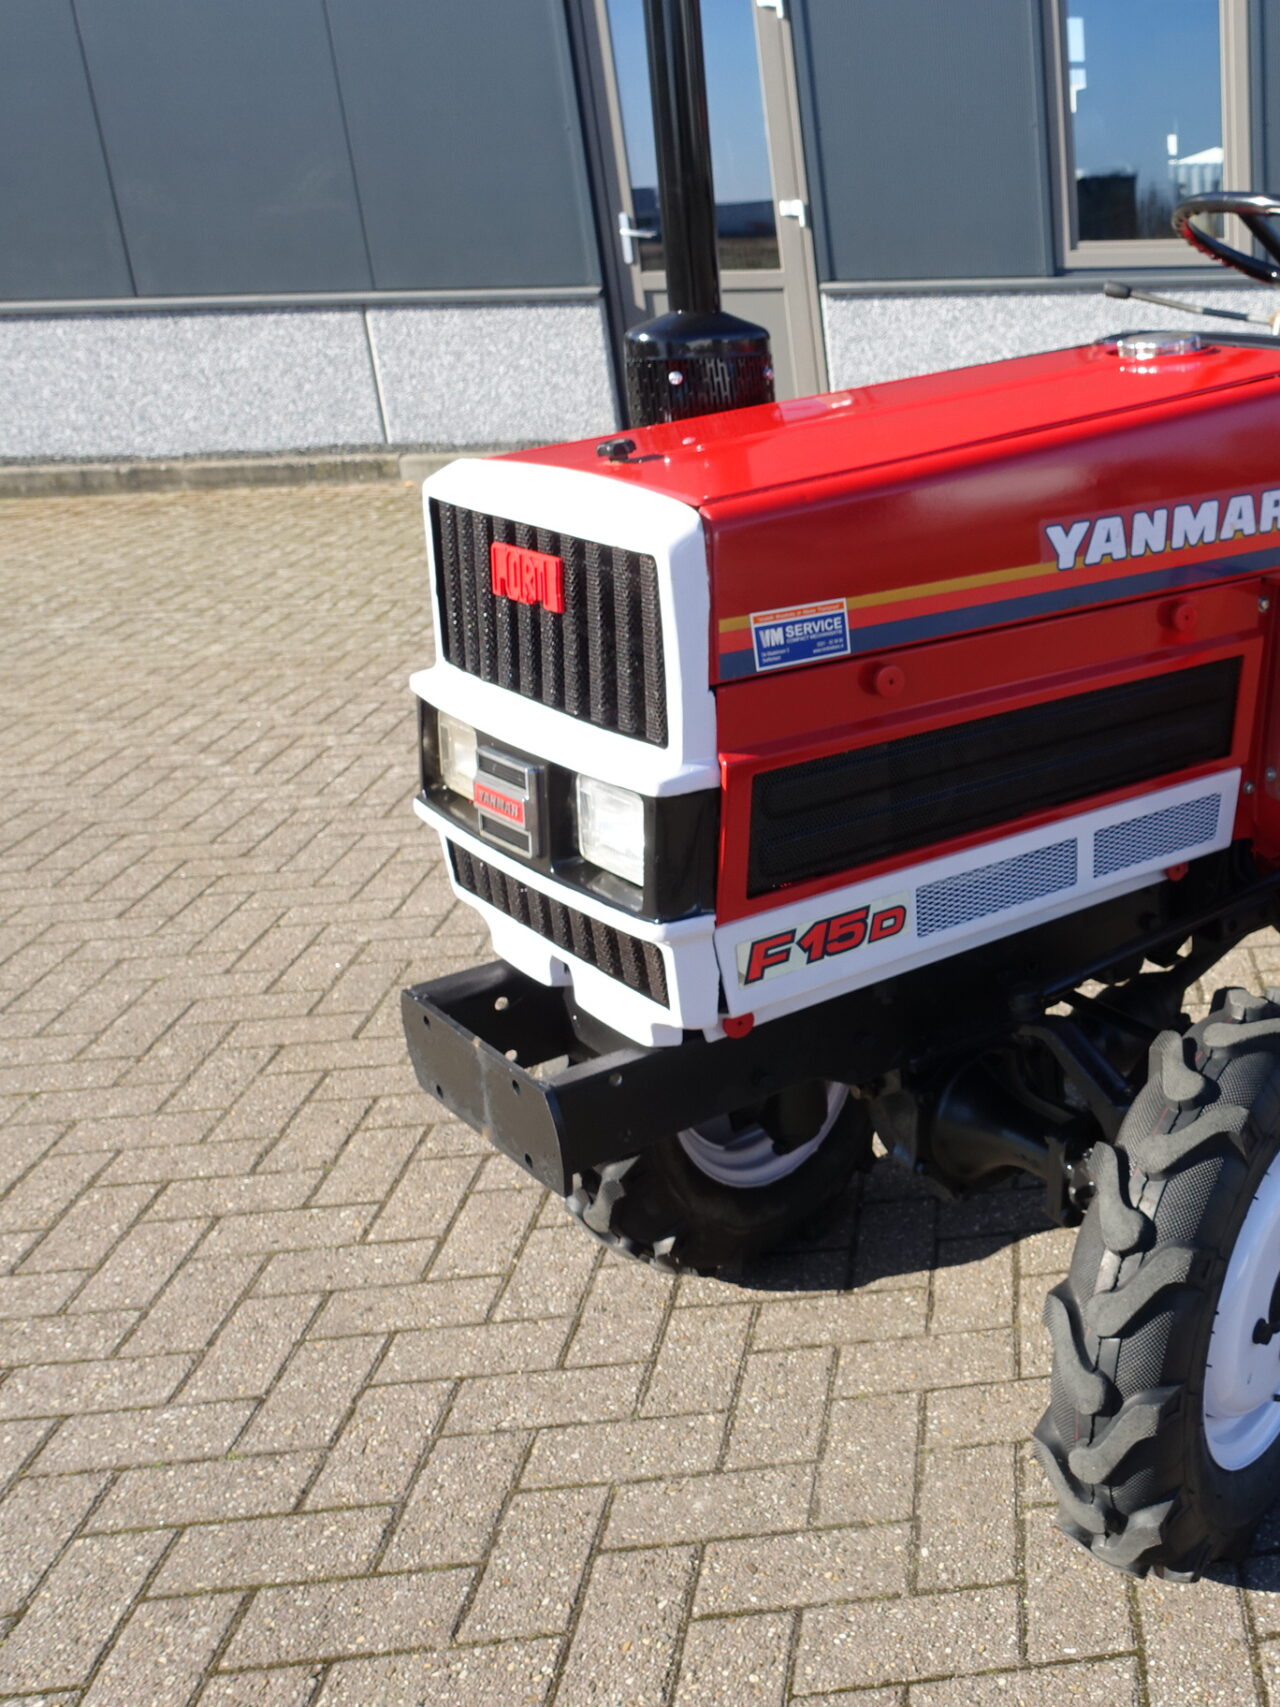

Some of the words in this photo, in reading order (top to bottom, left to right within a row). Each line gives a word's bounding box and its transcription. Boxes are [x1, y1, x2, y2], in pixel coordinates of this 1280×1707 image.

[759, 627, 784, 648] VM
[785, 616, 843, 637] SERVICE
[480, 790, 519, 818] YANMAR
[744, 904, 907, 985] F15D
